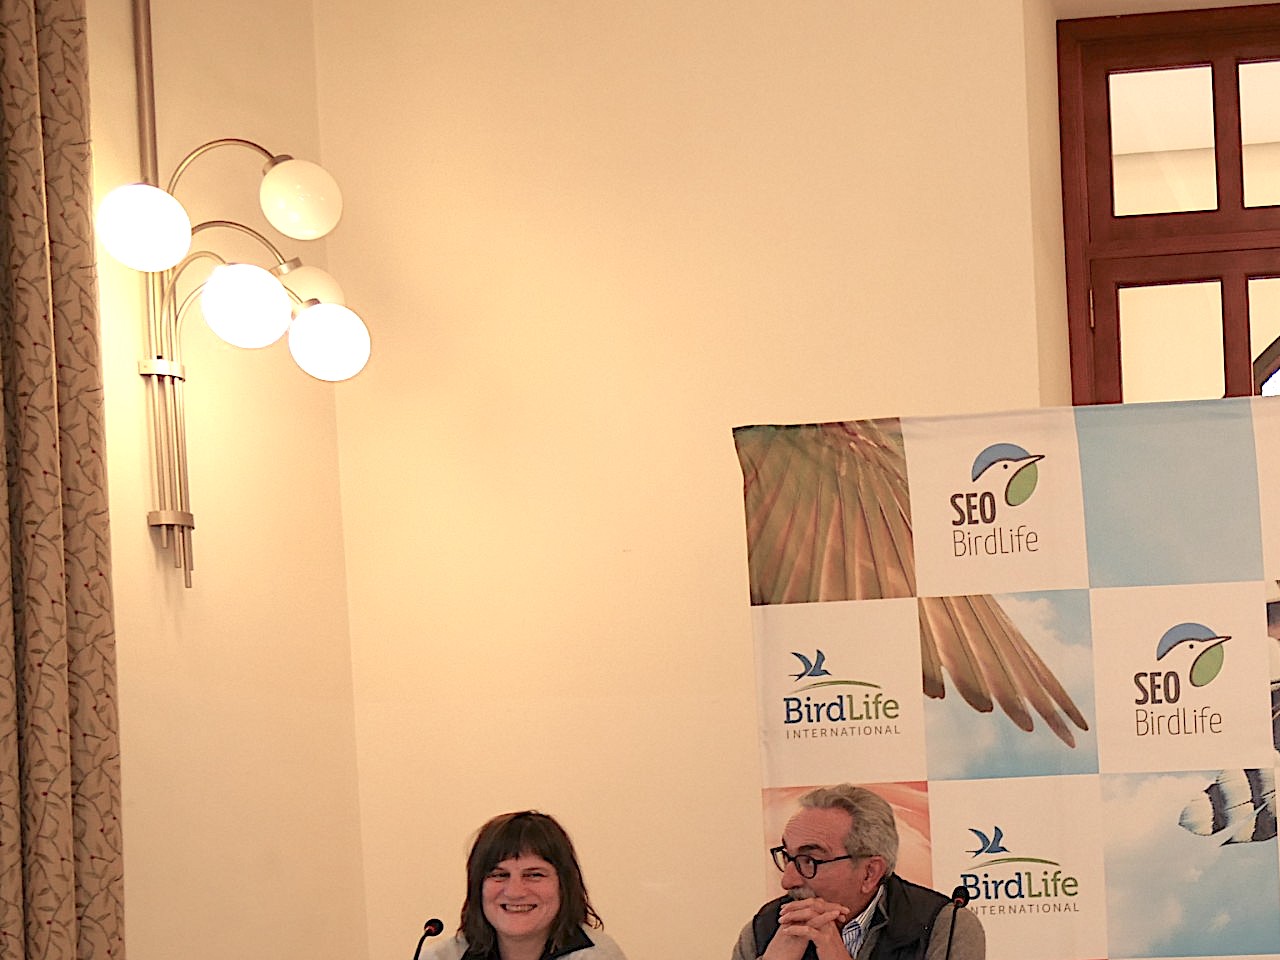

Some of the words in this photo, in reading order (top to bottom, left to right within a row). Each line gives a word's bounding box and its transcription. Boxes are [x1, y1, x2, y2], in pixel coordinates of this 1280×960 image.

[950, 491, 996, 526] SEO
[952, 526, 1039, 557] BirdLife
[1134, 670, 1180, 705] SEO
[783, 693, 899, 724] BirdLife
[1136, 705, 1223, 736] BirdLife
[786, 725, 901, 739] INTERNATIONAL
[960, 870, 1078, 899] BirdLife
[970, 902, 1080, 916] NTERNATIONAL
